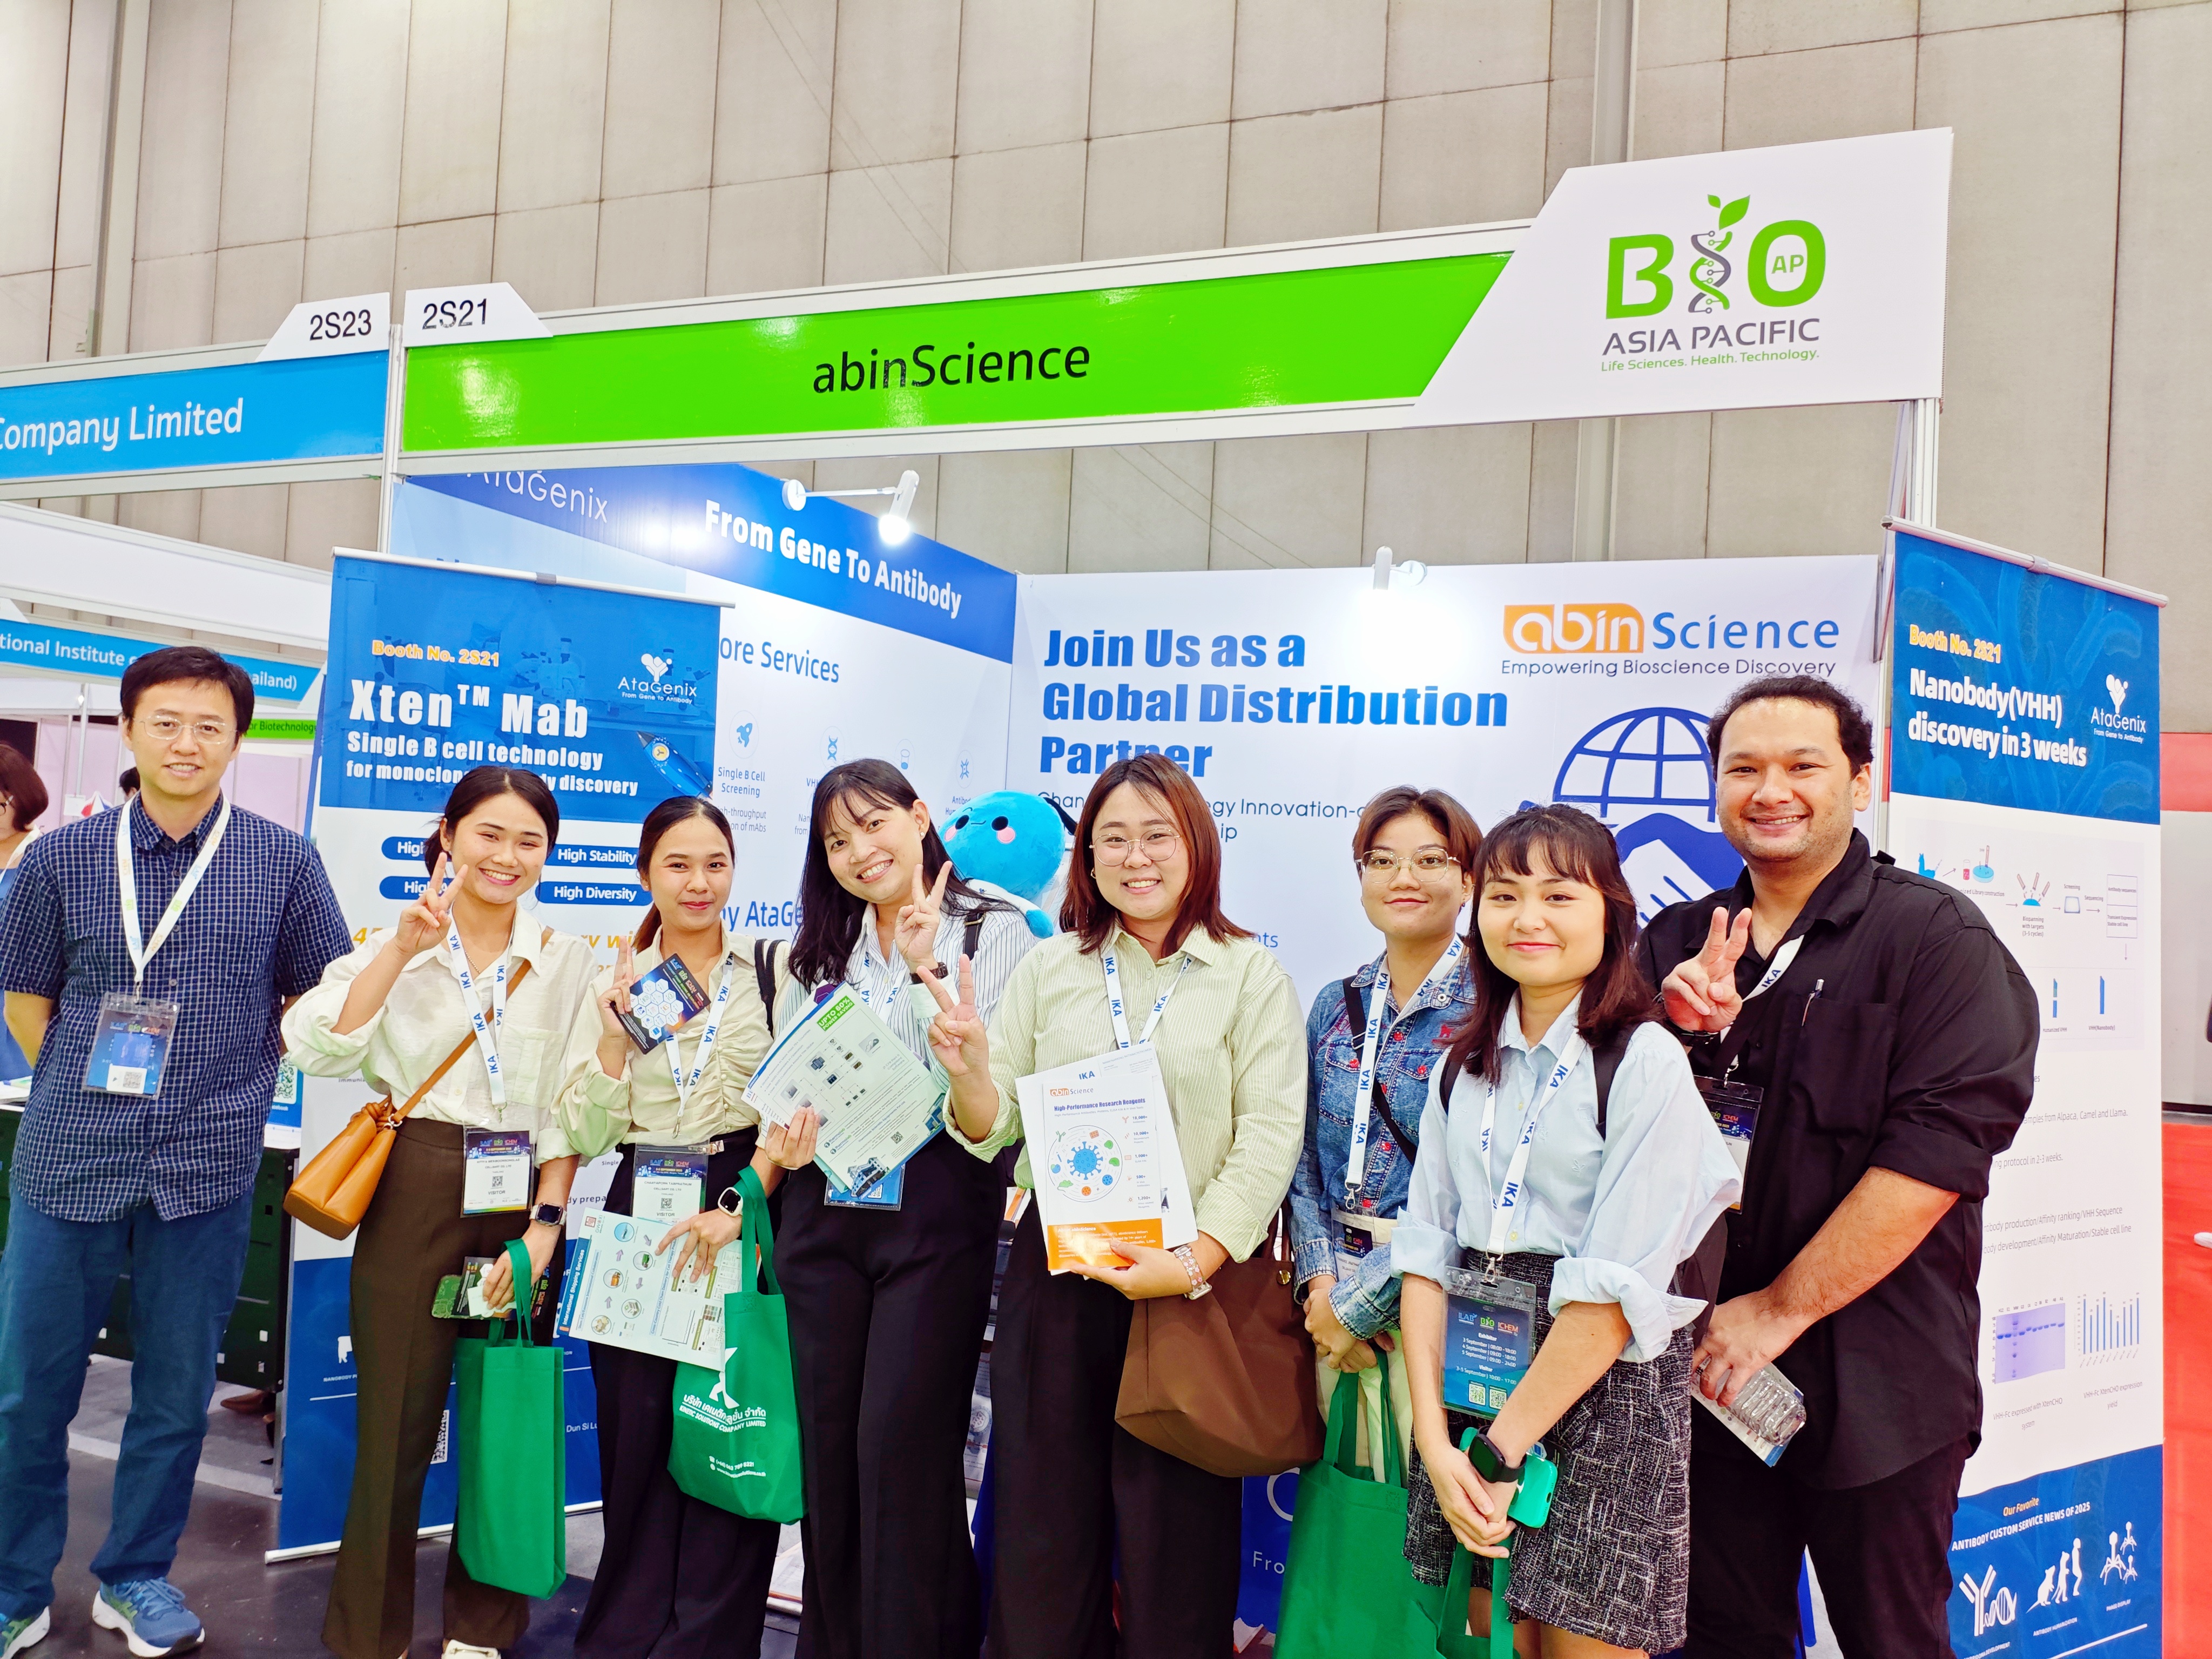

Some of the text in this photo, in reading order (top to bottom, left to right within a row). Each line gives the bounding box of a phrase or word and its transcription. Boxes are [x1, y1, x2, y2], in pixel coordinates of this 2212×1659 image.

[1771, 254, 1804, 274] AP
[422, 298, 487, 330] 2S21
[309, 309, 372, 341] 2S23
[1602, 318, 1820, 356] ASIA PACIFIC
[813, 341, 1090, 394] abinScience
[1601, 349, 1819, 372] Life Sciences. Health. Technology.
[129, 397, 245, 442] Limited
[467, 473, 608, 523] taGenix
[705, 500, 962, 619] From Gene To Antibody
[55, 640, 125, 666] Institute
[372, 640, 500, 667] Booth No. 2S21
[1044, 629, 1306, 668] Join Us as a
[1910, 624, 2001, 664] Booth No. 2S21
[719, 637, 840, 683] ore Services
[1502, 660, 1836, 677] Empowering Bioscience Discovery
[618, 676, 697, 698] AtaGenix
[667, 696, 693, 705] Antibody
[1042, 683, 1508, 727] Global Distribution
[1910, 668, 2062, 728] Nanobody(VHH)
[501, 694, 588, 739] Mab
[2090, 707, 2147, 733] AtaGenix
[1908, 711, 2087, 767] discovery in 3 weeks
[347, 731, 603, 771] Single B cell technology
[347, 760, 373, 779] for
[559, 776, 638, 797] discovery
[718, 767, 766, 782] Single B Cell
[721, 783, 760, 798] Screening
[740, 822, 766, 832] of mAbs
[795, 826, 808, 835] from
[558, 848, 637, 866] High Stability
[554, 886, 637, 903] High Diversity
[450, 934, 460, 950] IKA
[1447, 940, 1462, 957] IKA
[496, 965, 504, 983] IKA
[1105, 956, 1115, 975] IKA
[460, 971, 472, 989] IKA
[1376, 972, 1388, 990] IKA
[1761, 968, 1782, 988] IKA
[718, 986, 728, 1002] IKA
[886, 987, 898, 1004] IKA
[1154, 995, 1168, 1013] IKA
[822, 1002, 853, 1031] POWER SAVING
[1111, 999, 1122, 1017] IKA
[474, 1012, 485, 1031] IKA
[1367, 1018, 1378, 1038] IKA
[704, 1026, 716, 1042] IKA
[673, 1068, 682, 1086] IKA
[689, 1069, 702, 1087] IKA
[1079, 1070, 1095, 1080] IKA
[1360, 1069, 1371, 1091] IKA
[1550, 1064, 1568, 1088] IKA
[1054, 1102, 1098, 1112] High-Performance
[1099, 1100, 1122, 1108] Research
[2045, 1108, 2128, 1122] from Alpaca, Camel and Llama.
[1355, 1122, 1366, 1145] IKA
[1482, 1127, 1490, 1152] IKA
[2003, 1156, 2029, 1169] protocol
[2030, 1156, 2035, 1164] in
[2036, 1154, 2045, 1164] 2-3
[2045, 1152, 2063, 1162] weeks.
[1502, 1182, 1518, 1207] IKA
[2057, 1206, 2123, 1222] ranking/VHH Sequence
[2057, 1224, 2132, 1243] Maturation/Stable cell line
[562, 1249, 585, 1325] International Shipping Services
[2011, 1404, 2033, 1417] expressed
[2041, 1397, 2063, 1408] XtenCHO
[566, 1423, 589, 1433] Dun Si
[679, 1405, 696, 1417] KINETIC
[695, 1412, 720, 1429] SOLUTIONS
[719, 1422, 745, 1432] COMPANY
[2003, 1497, 2039, 1517] Our Favorite
[1952, 1501, 2090, 1552] ANTIBODY CUSTOM SERVICE NEWS OF 2025
[1253, 1550, 1285, 1575] Fro
